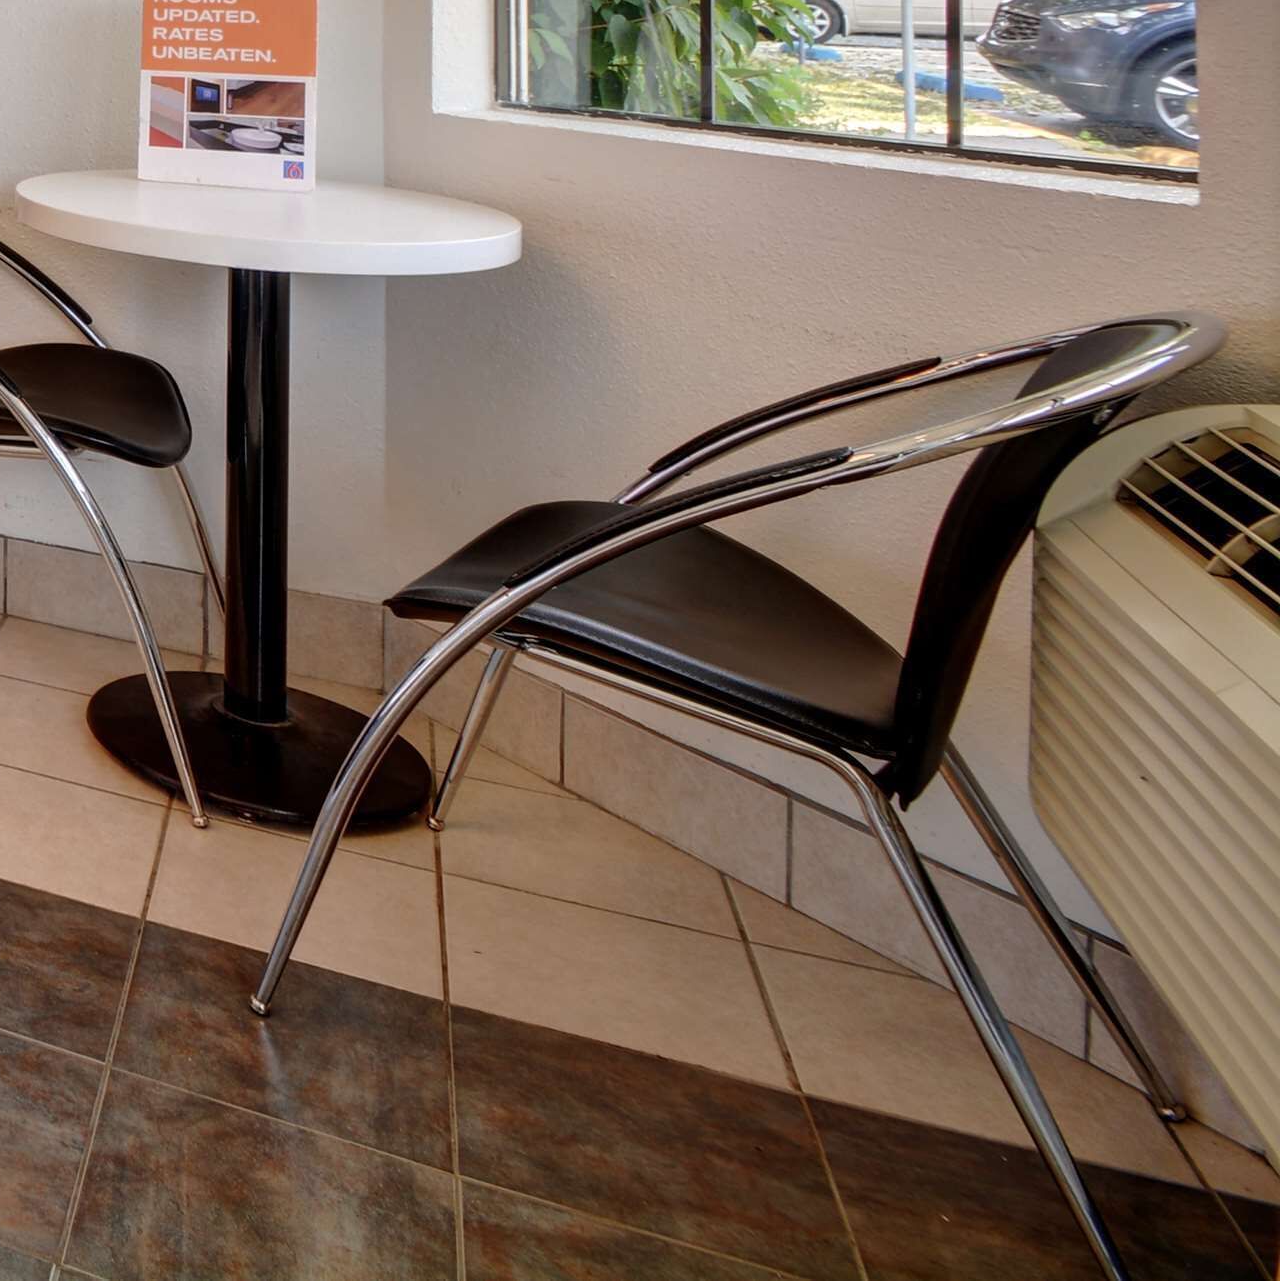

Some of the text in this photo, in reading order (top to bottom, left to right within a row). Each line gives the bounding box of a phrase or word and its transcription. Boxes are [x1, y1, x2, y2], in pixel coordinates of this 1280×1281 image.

[153, 8, 260, 24] UPDATED.
[152, 27, 224, 42] RATES
[152, 46, 277, 64] UNBEATEN.
